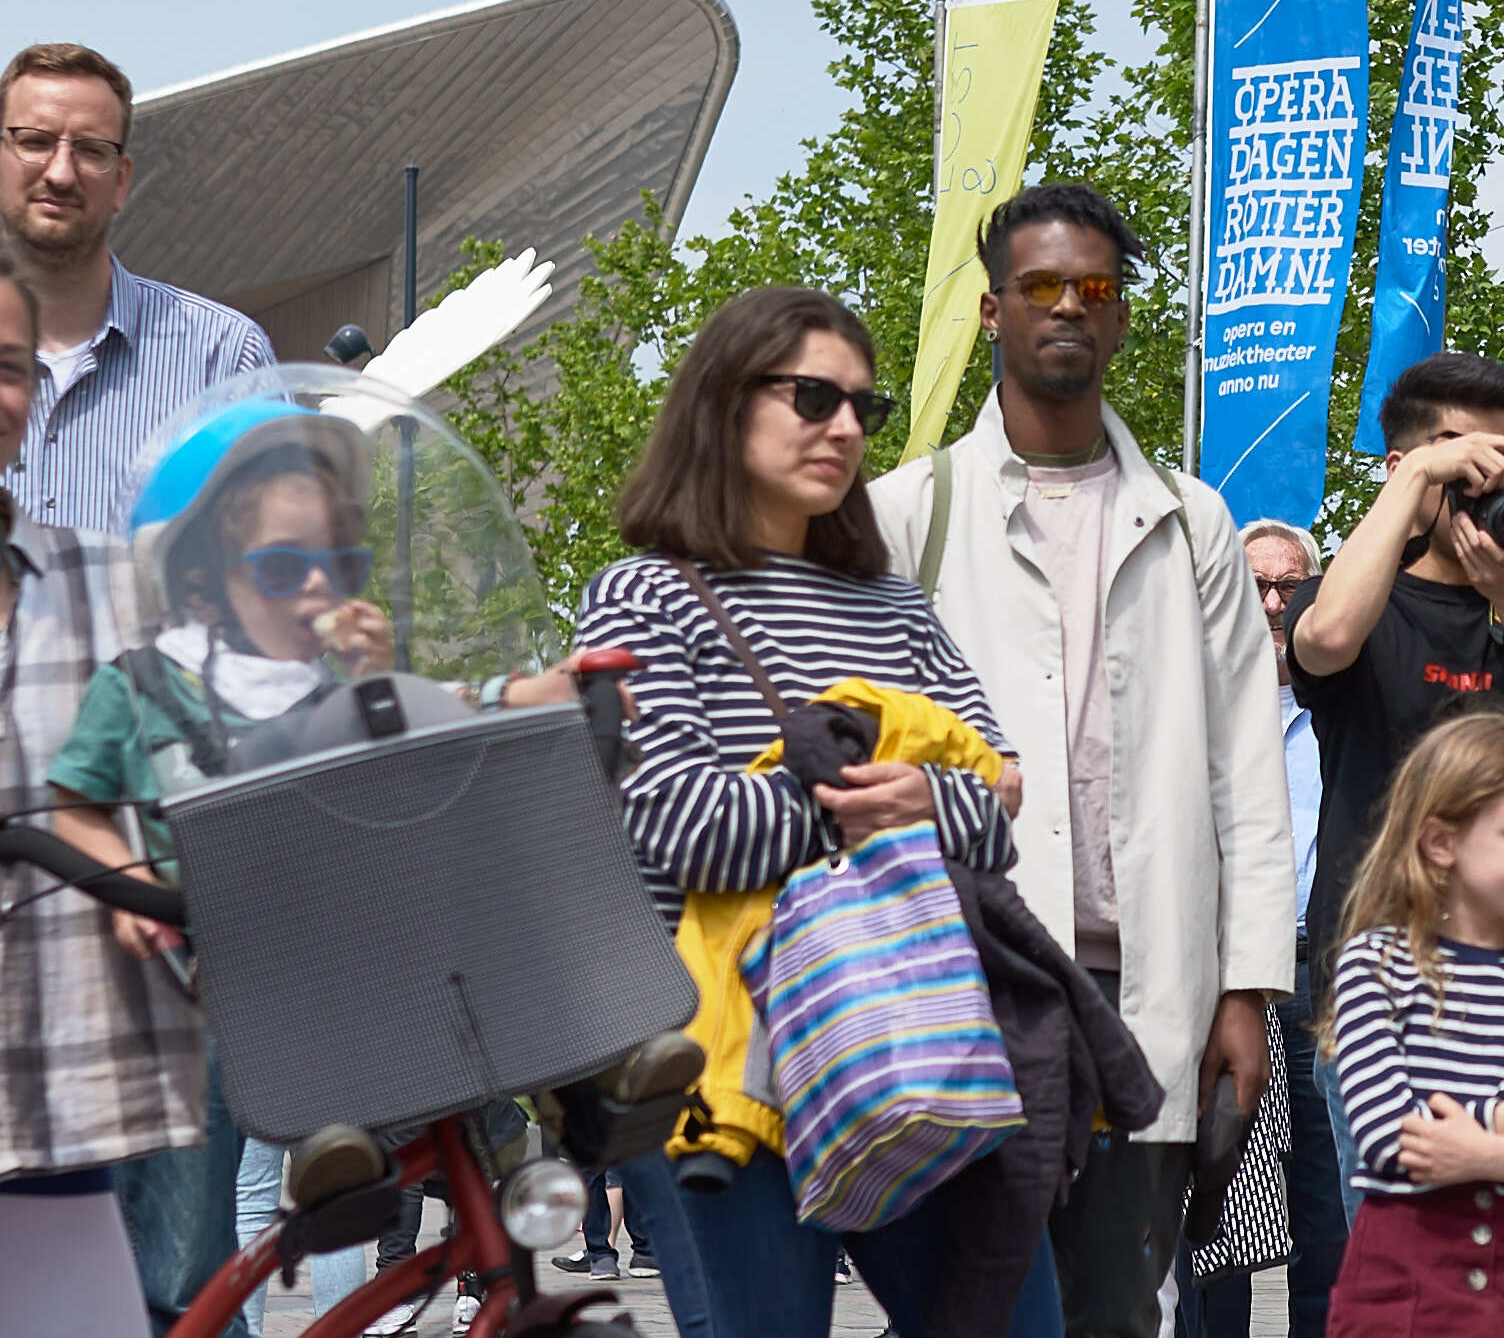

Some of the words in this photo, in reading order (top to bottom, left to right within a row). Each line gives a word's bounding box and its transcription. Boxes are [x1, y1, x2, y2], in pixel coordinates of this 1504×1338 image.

[1234, 70, 1355, 124] OPERA
[1229, 132, 1354, 184] DAGEN
[1223, 194, 1344, 243] ROTTER
[1214, 249, 1336, 302] DAM.NL
[1223, 320, 1266, 346] opera
[1269, 320, 1297, 336] en
[1204, 344, 1317, 373] muziektheater
[1218, 375, 1255, 397] anno
[1257, 373, 1280, 390] nu
